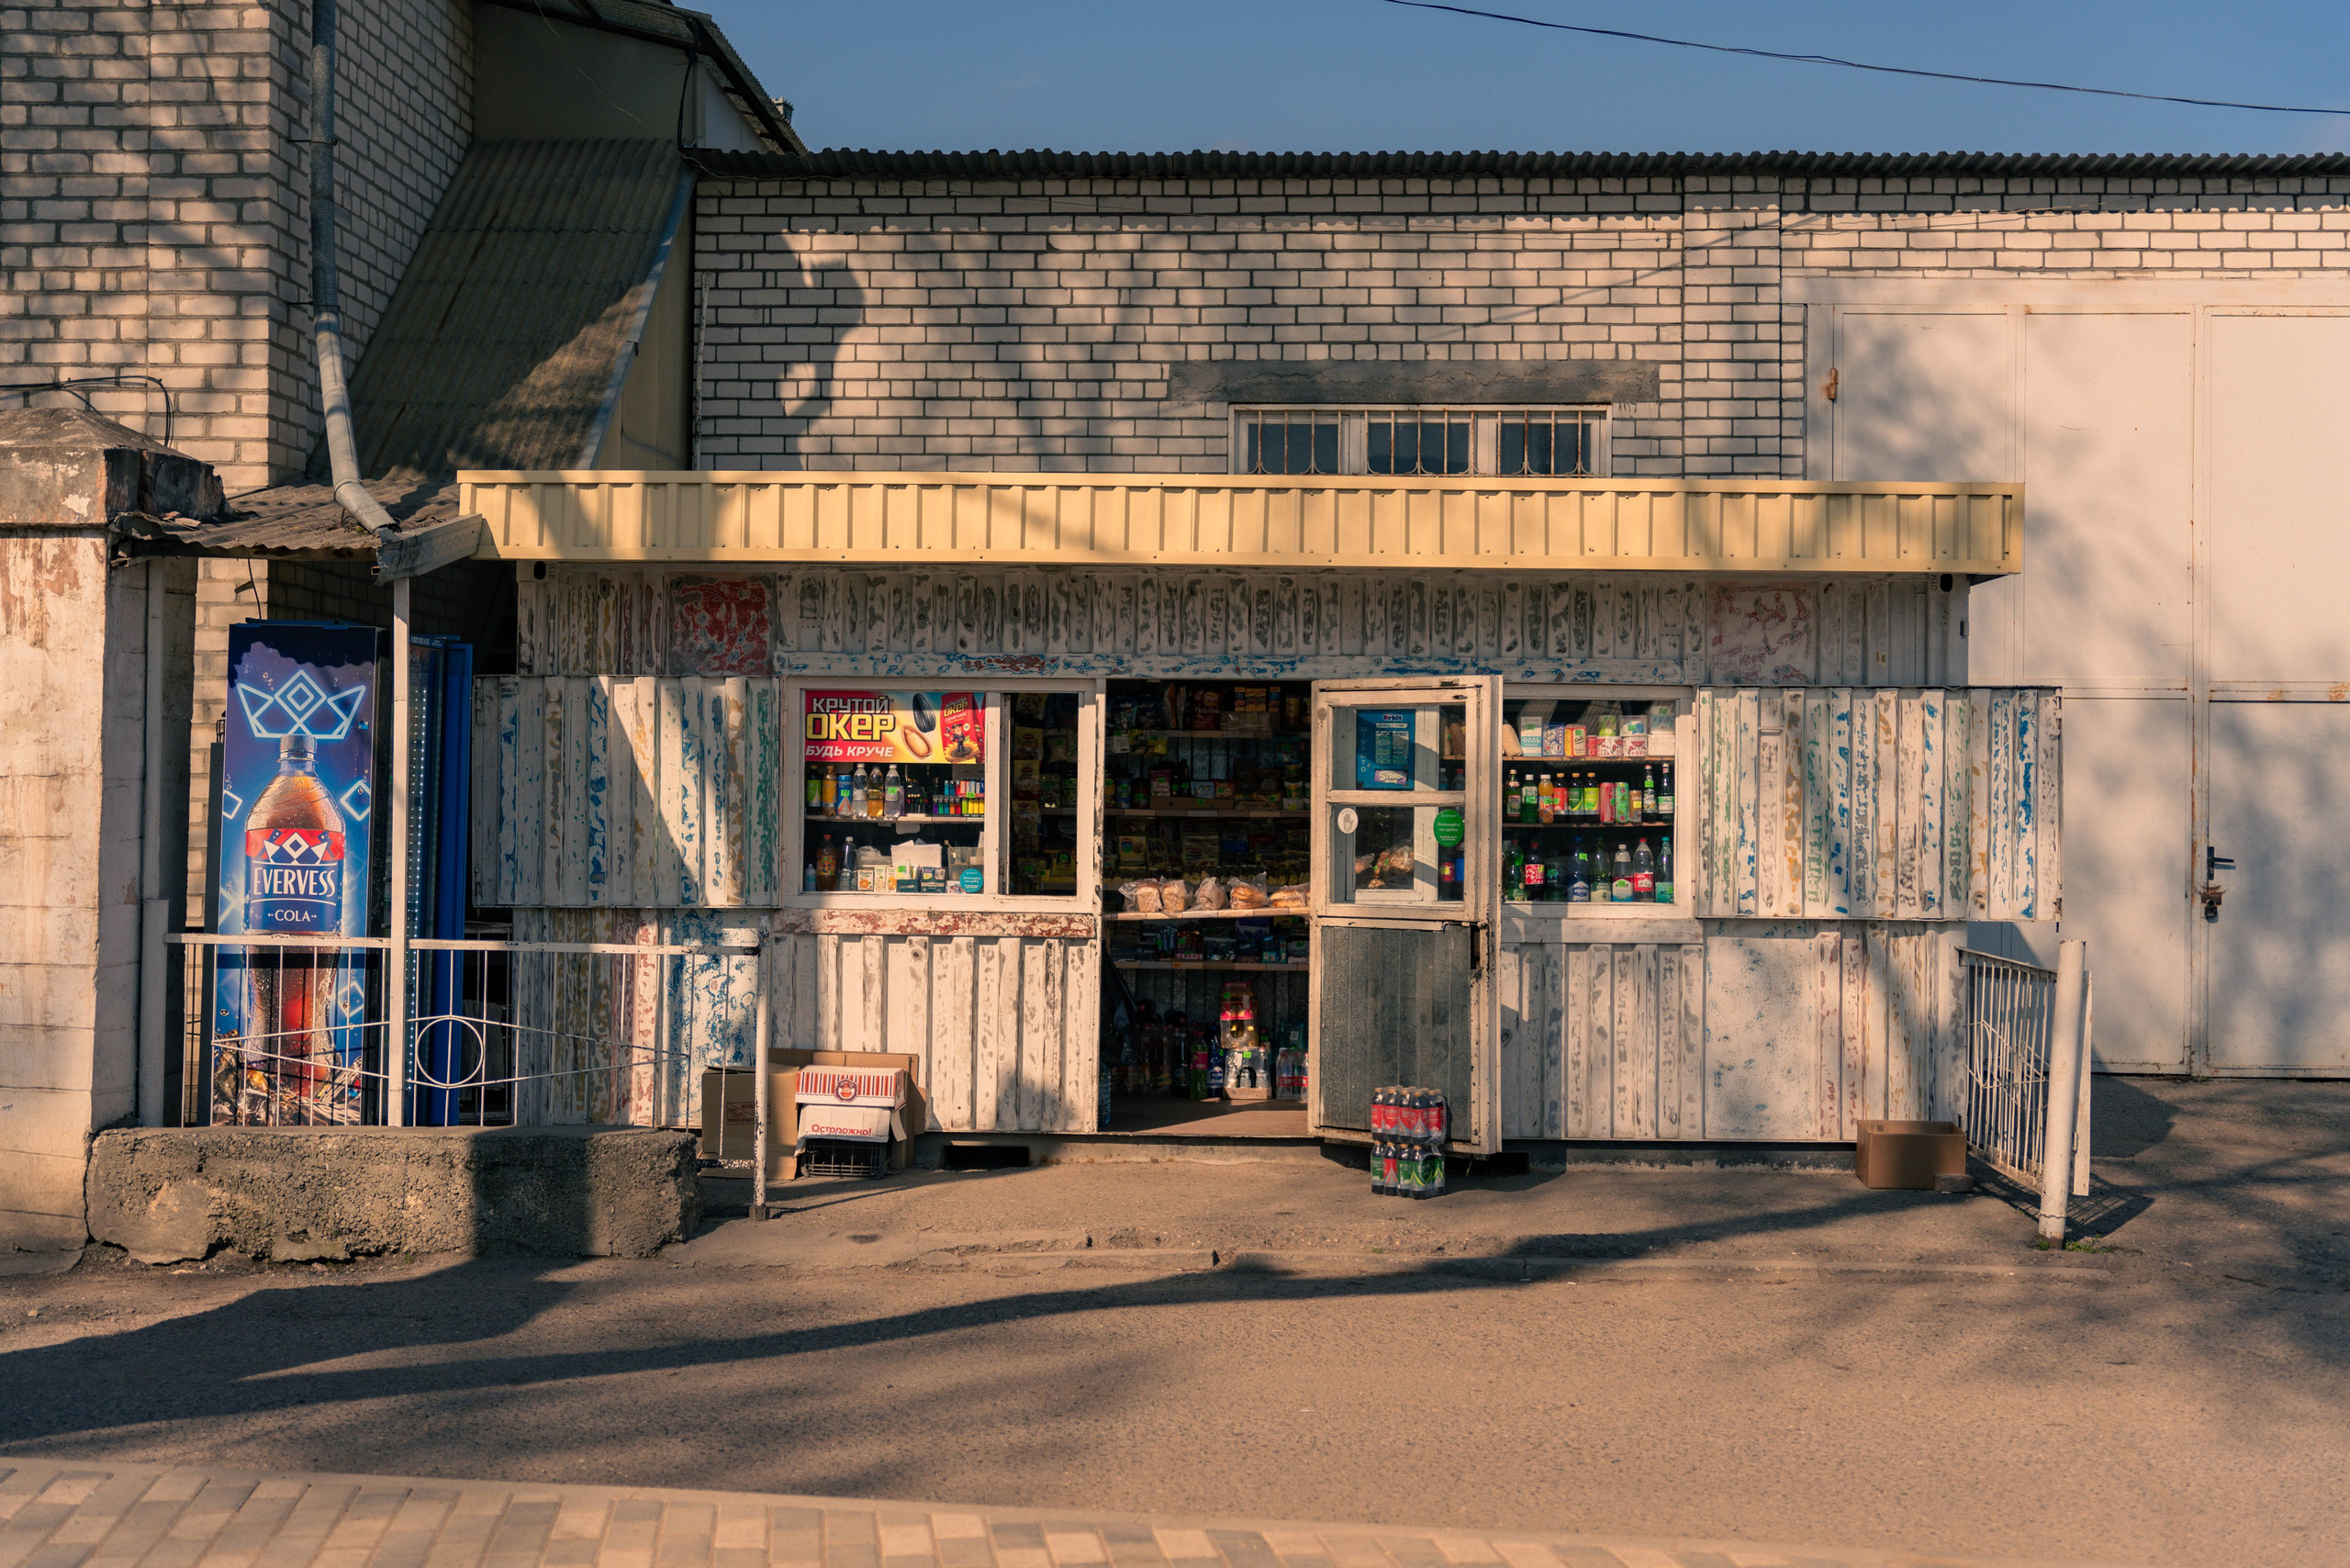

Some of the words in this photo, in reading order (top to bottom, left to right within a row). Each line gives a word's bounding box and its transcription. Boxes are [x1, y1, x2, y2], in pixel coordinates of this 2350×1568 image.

[812, 695, 890, 713] КРУТОЙ
[806, 745, 843, 757] БУДЬ
[846, 746, 894, 757] КРУЧЕ
[253, 867, 336, 898] EVERVESS
[274, 909, 311, 923] COLA
[811, 1124, 872, 1137] Осторожно!
